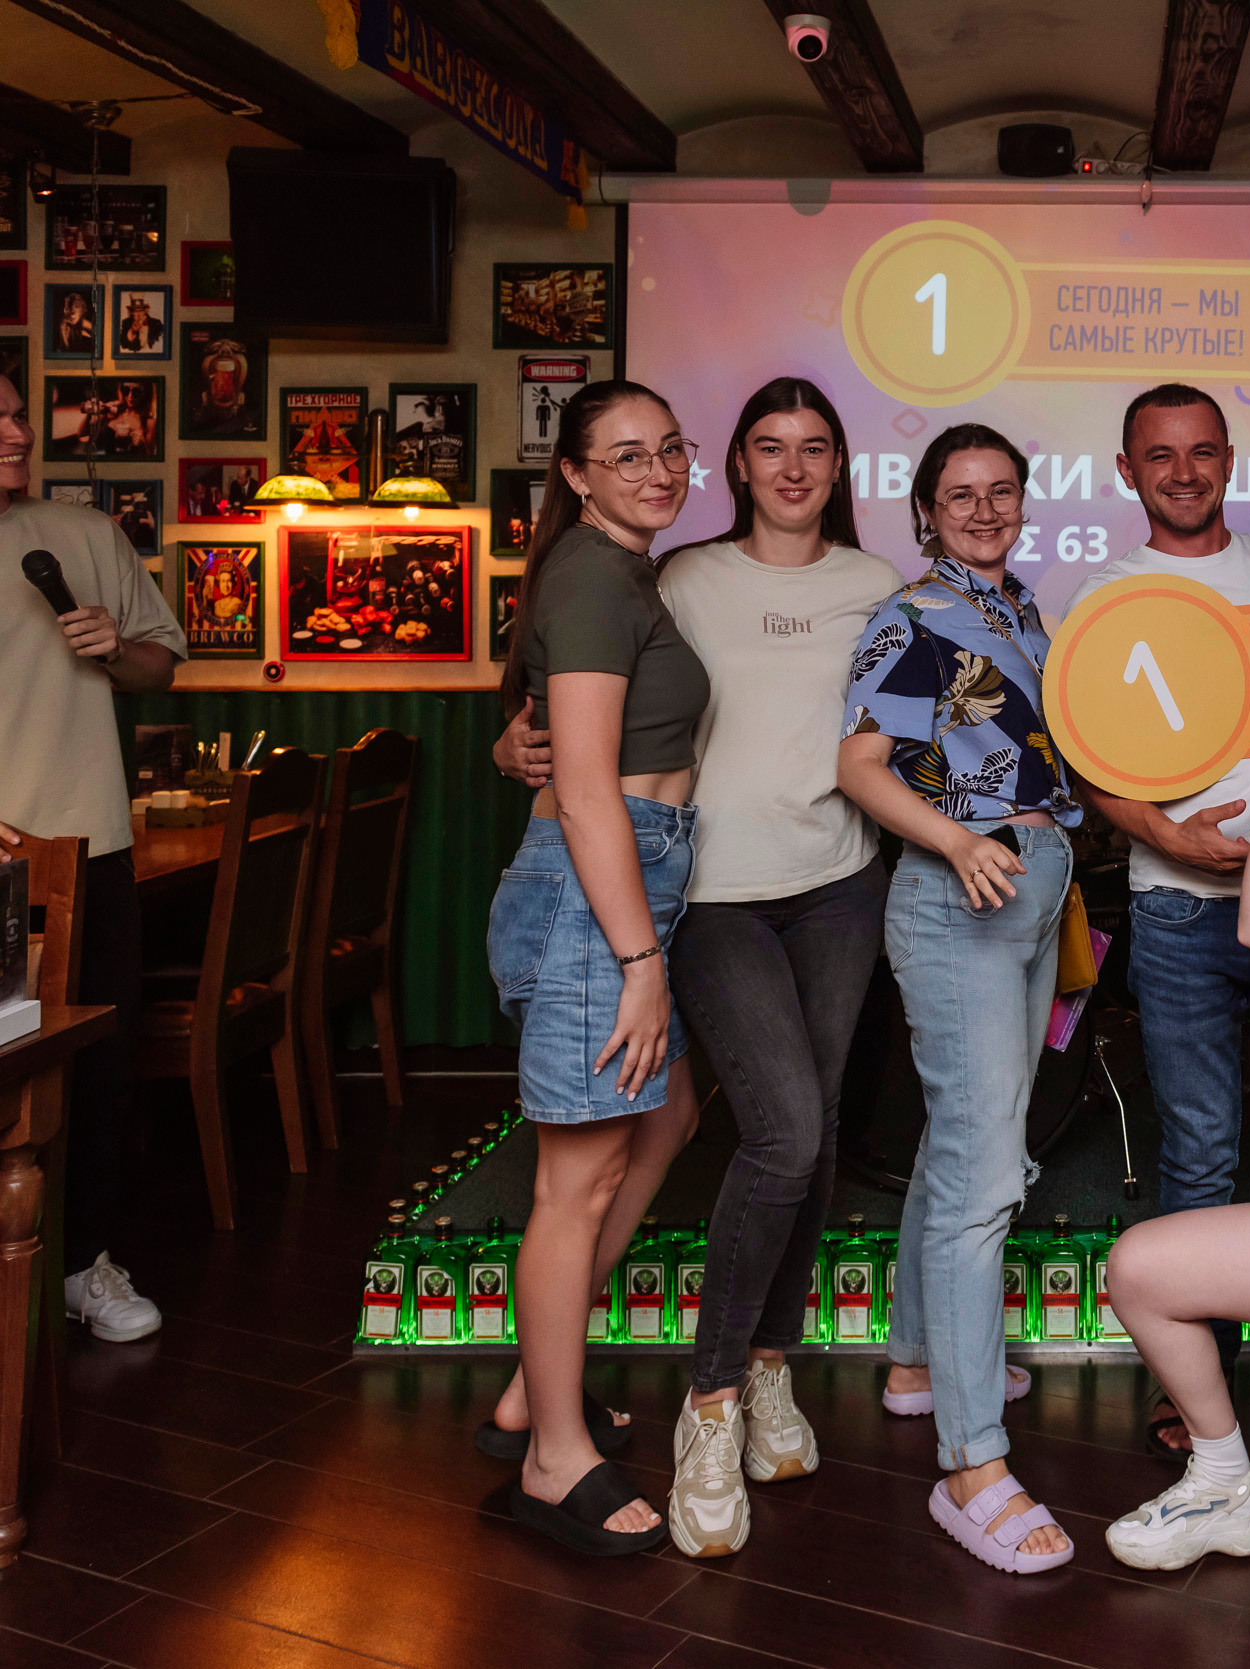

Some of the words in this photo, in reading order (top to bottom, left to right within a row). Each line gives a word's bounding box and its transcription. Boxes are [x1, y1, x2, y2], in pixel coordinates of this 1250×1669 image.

[914, 273, 947, 356] 1
[1057, 284, 1162, 319] СЕГОДНЯ
[1199, 289, 1240, 317] МЫ
[1050, 324, 1135, 354] САМЫЕ
[1145, 327, 1244, 357] КРУТЫЕ!
[530, 365, 577, 377] WARNING
[288, 393, 360, 405] ТРЕХГОРНОЕ
[523, 443, 552, 453] NERVOUS
[1056, 525, 1109, 563] 63
[190, 631, 254, 644] BREWCO
[762, 616, 813, 639] light
[1122, 640, 1185, 732] 1
